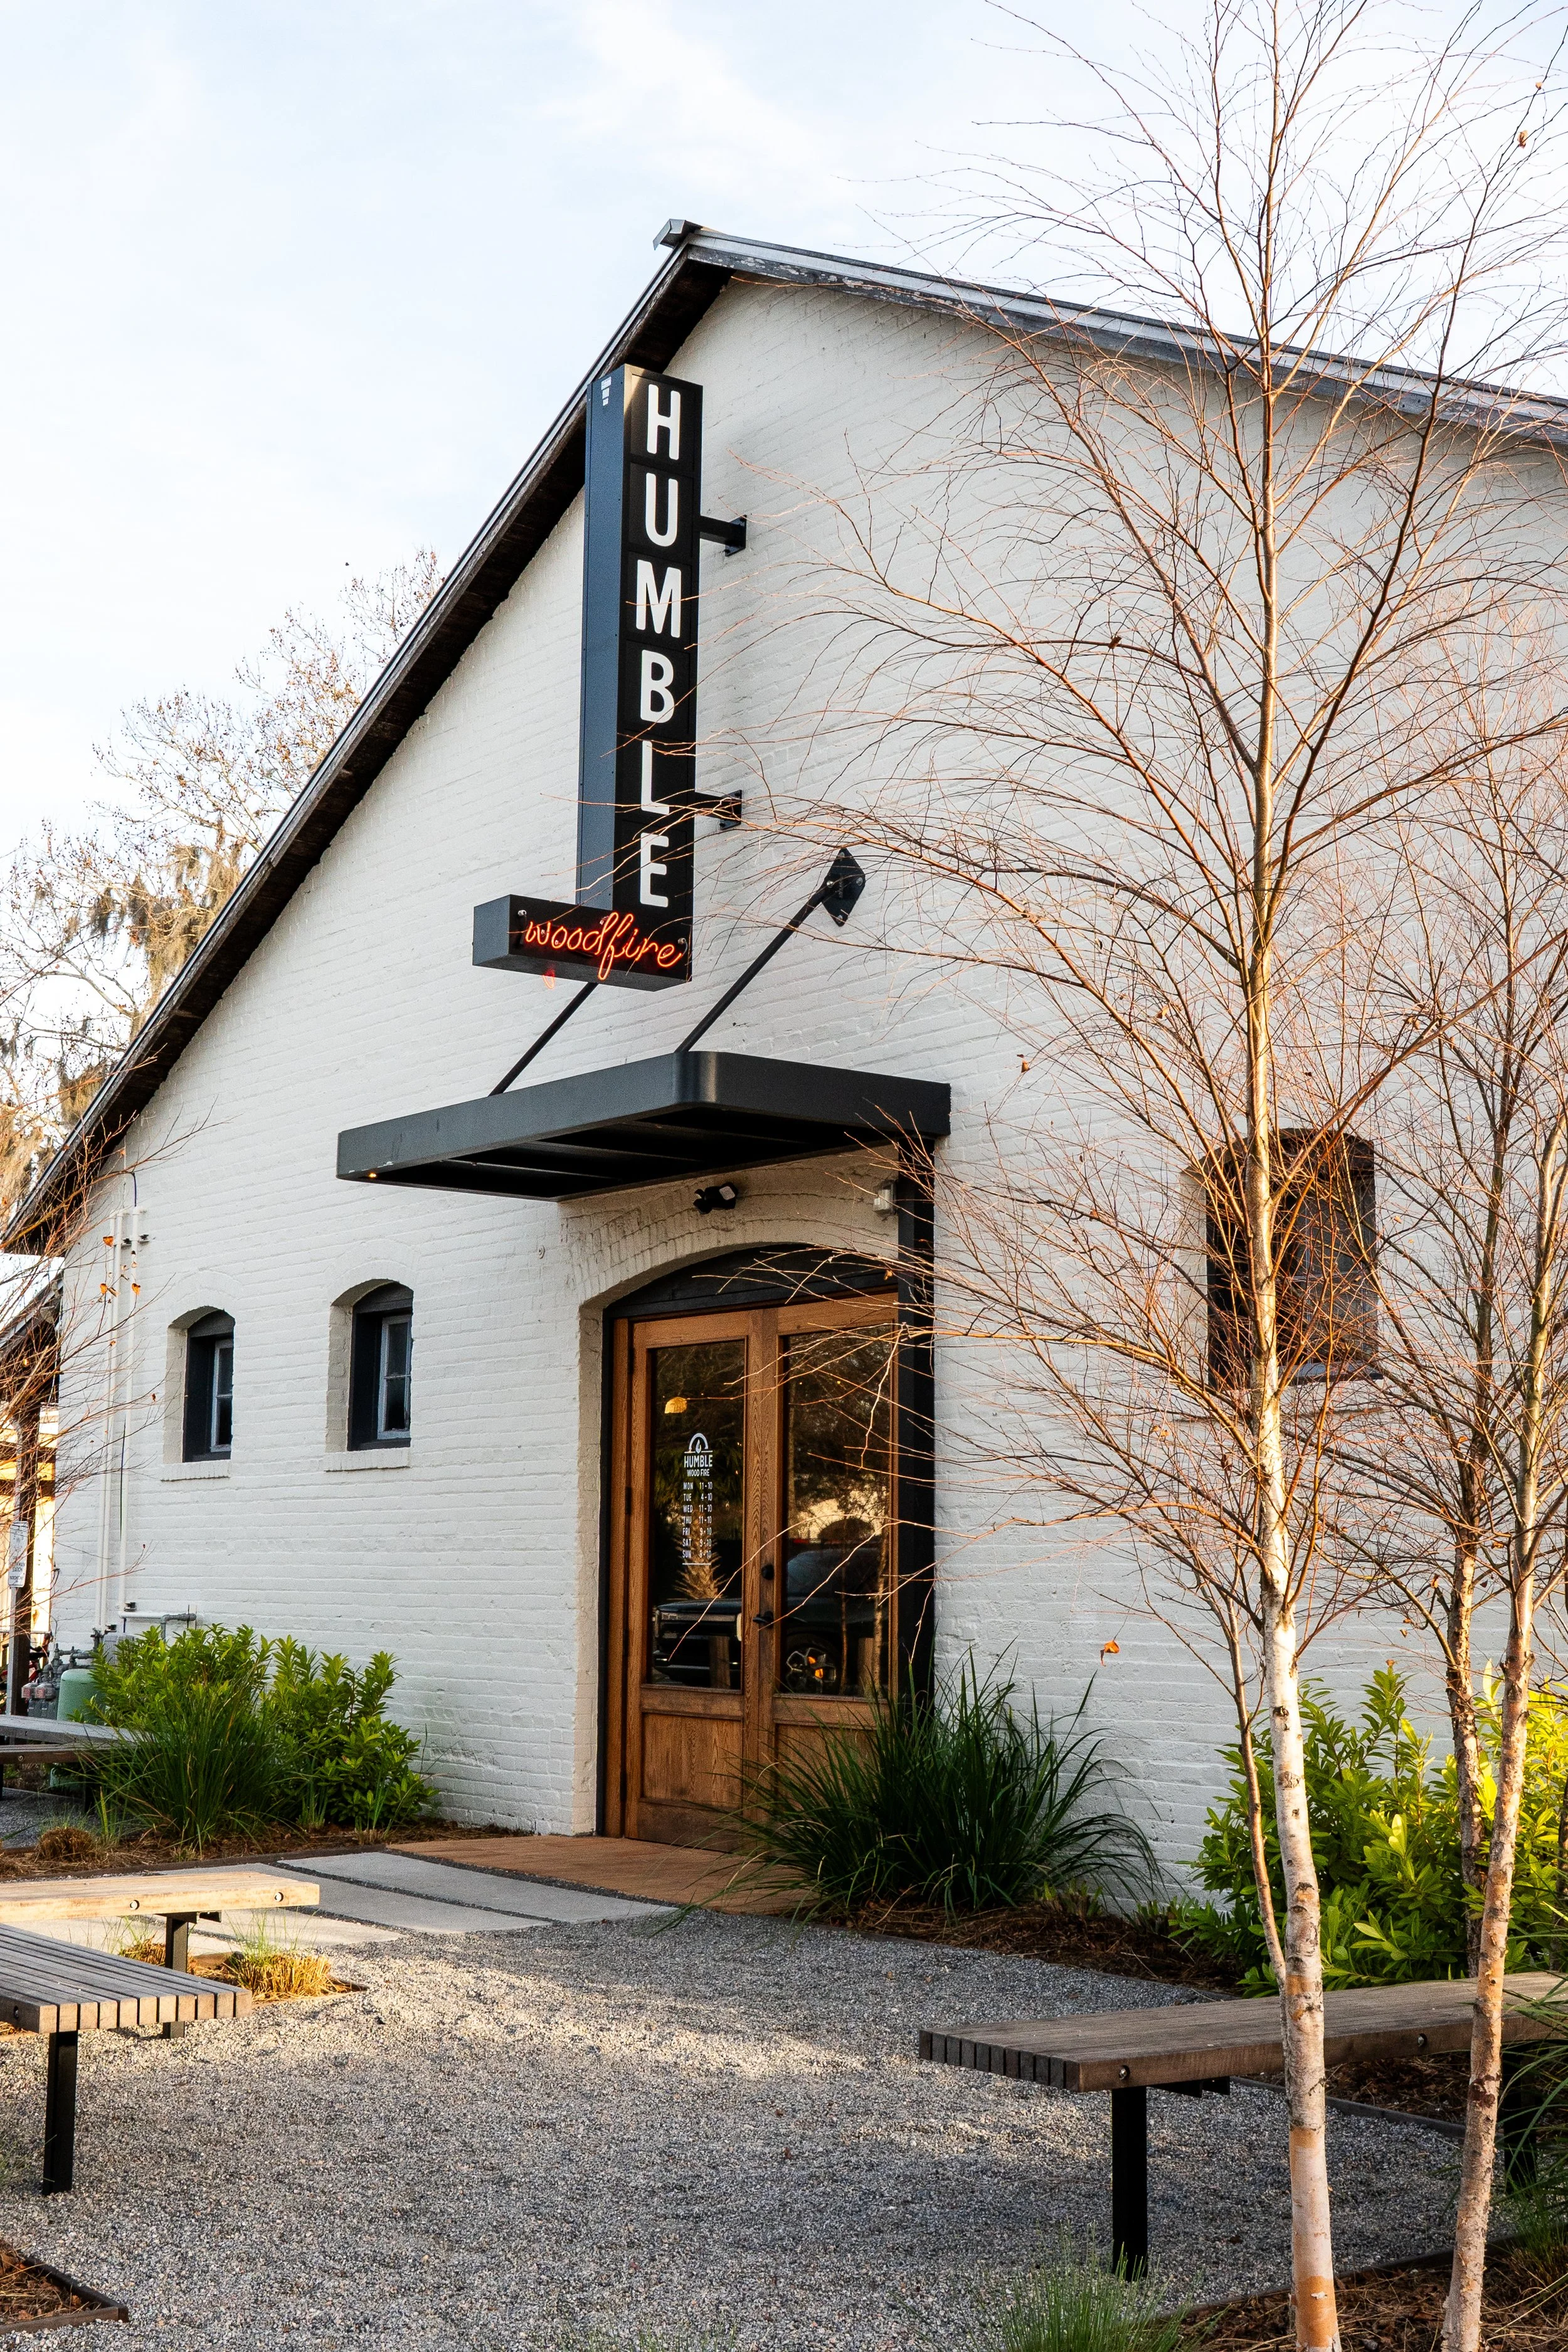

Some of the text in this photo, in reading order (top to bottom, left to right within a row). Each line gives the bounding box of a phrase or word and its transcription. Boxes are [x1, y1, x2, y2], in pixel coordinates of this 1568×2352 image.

[635, 383, 681, 908] HUMBLE
[525, 911, 682, 980] woodfire
[684, 1454, 713, 1468] HUMBLE
[700, 1468, 710, 1476] FIRE
[683, 1505, 693, 1513] WED
[683, 1516, 692, 1524] THU
[682, 1527, 691, 1535] FRI
[682, 1538, 692, 1547] SAT
[682, 1549, 692, 1558] SUN
